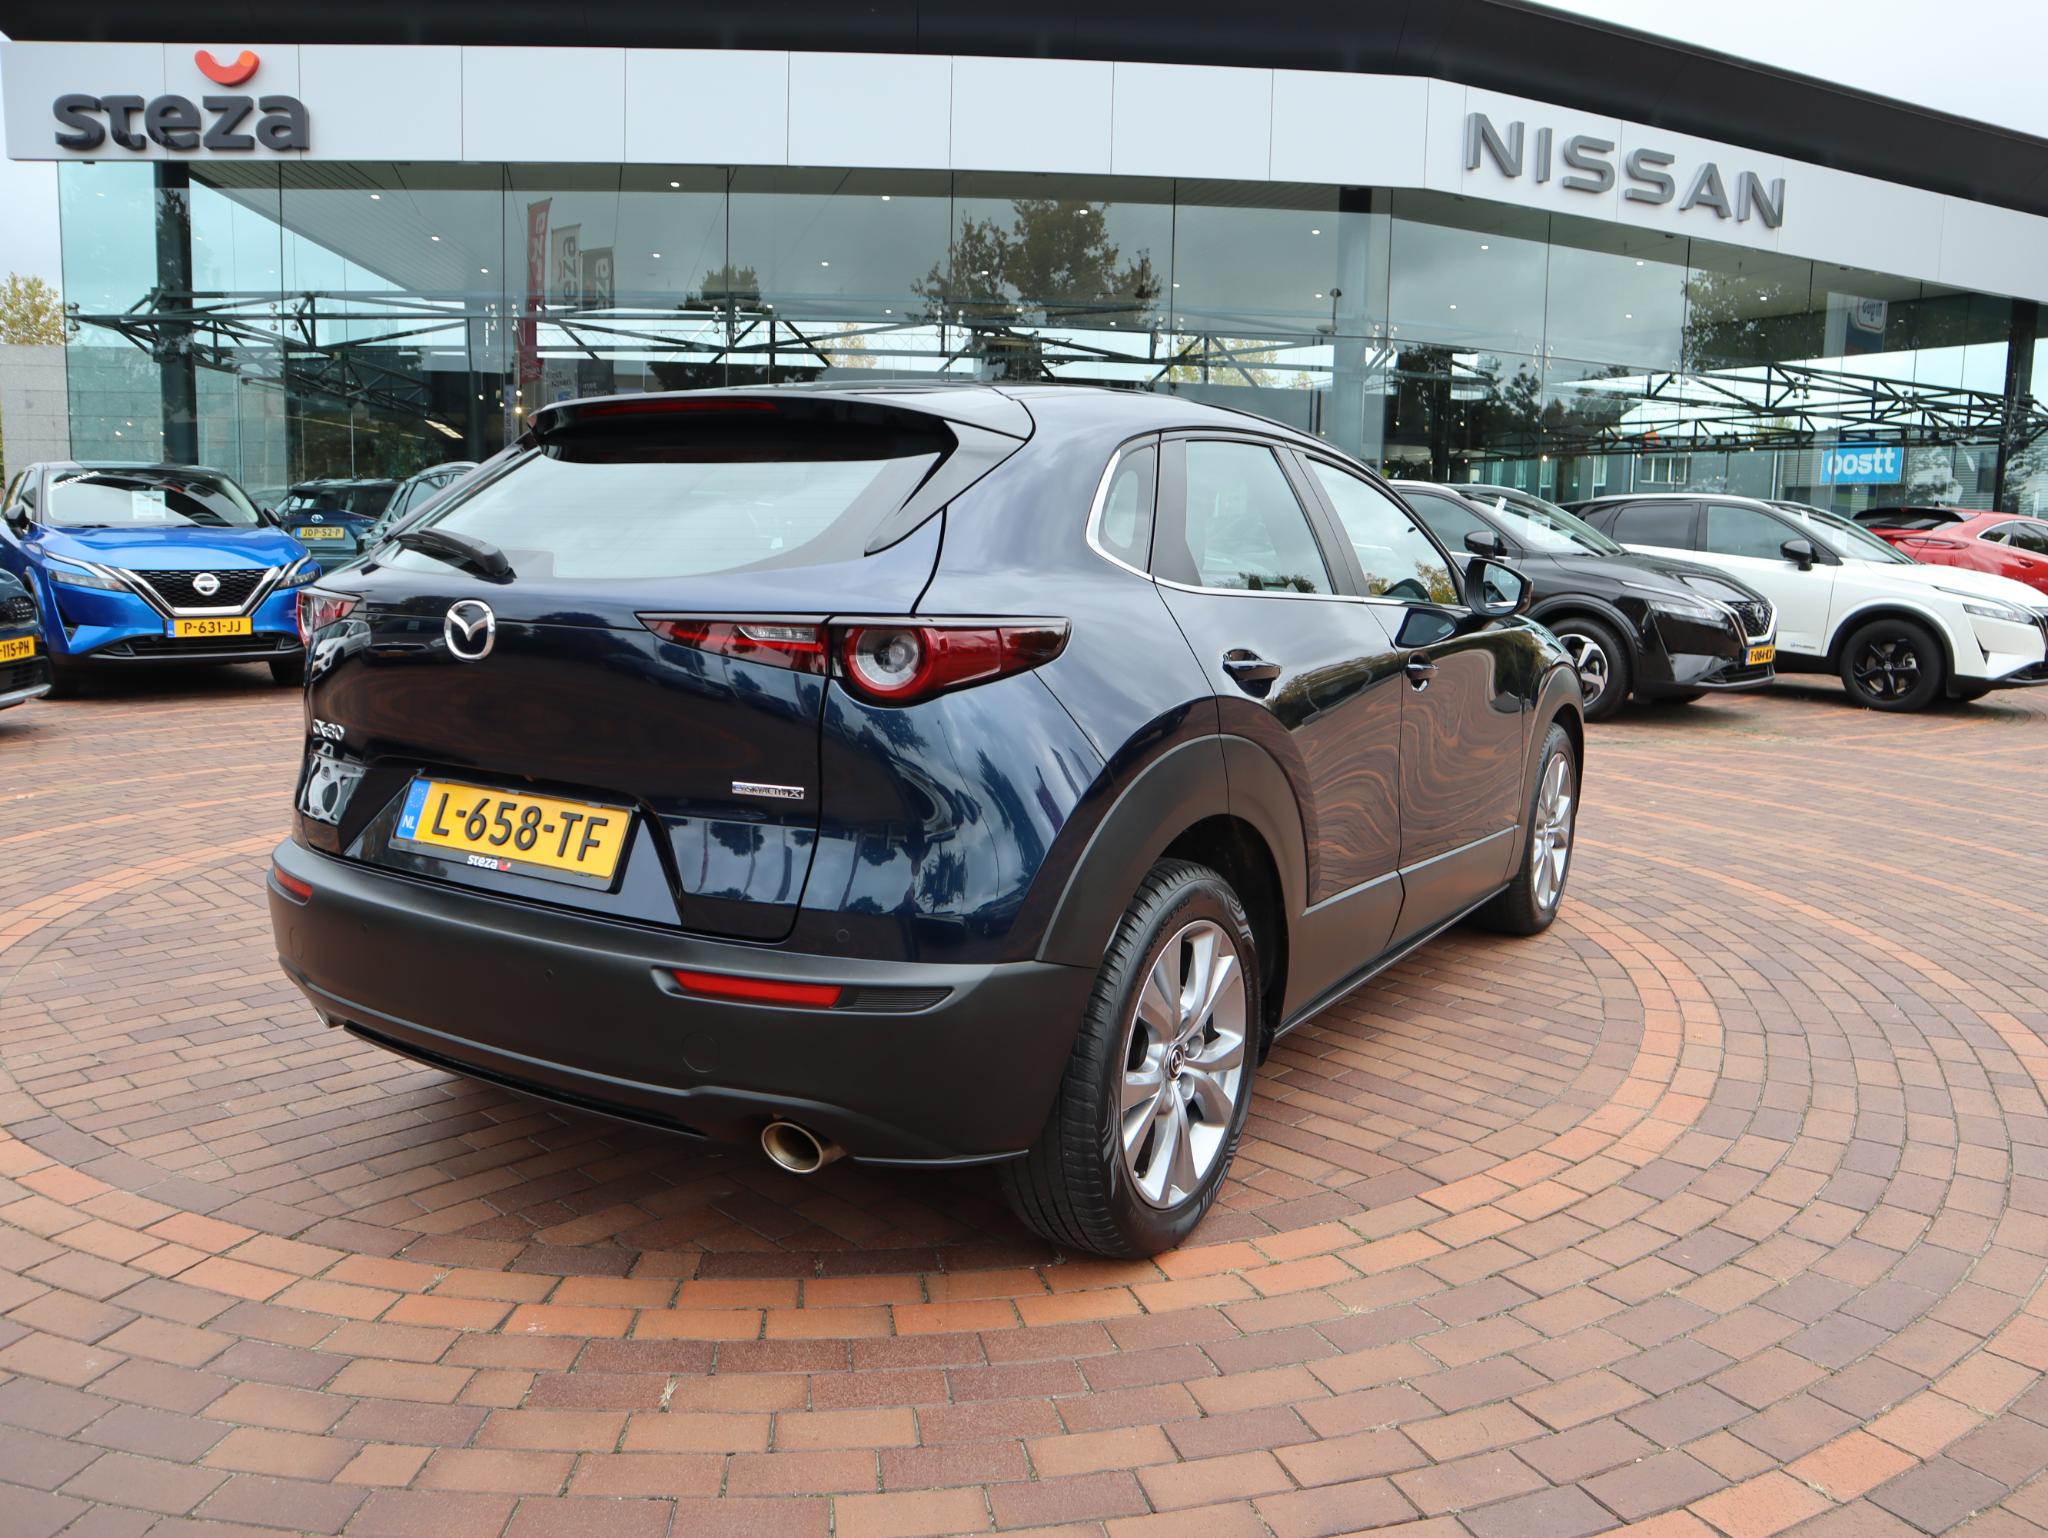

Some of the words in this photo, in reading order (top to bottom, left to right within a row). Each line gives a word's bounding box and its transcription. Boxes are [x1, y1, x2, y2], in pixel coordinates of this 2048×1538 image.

[53, 93, 310, 151] steza
[1466, 111, 1786, 229] NISSAN
[183, 620, 242, 635] P-631-JJ
[402, 814, 415, 830] NL
[431, 793, 609, 862] L-658-TF
[466, 854, 498, 870] steza
